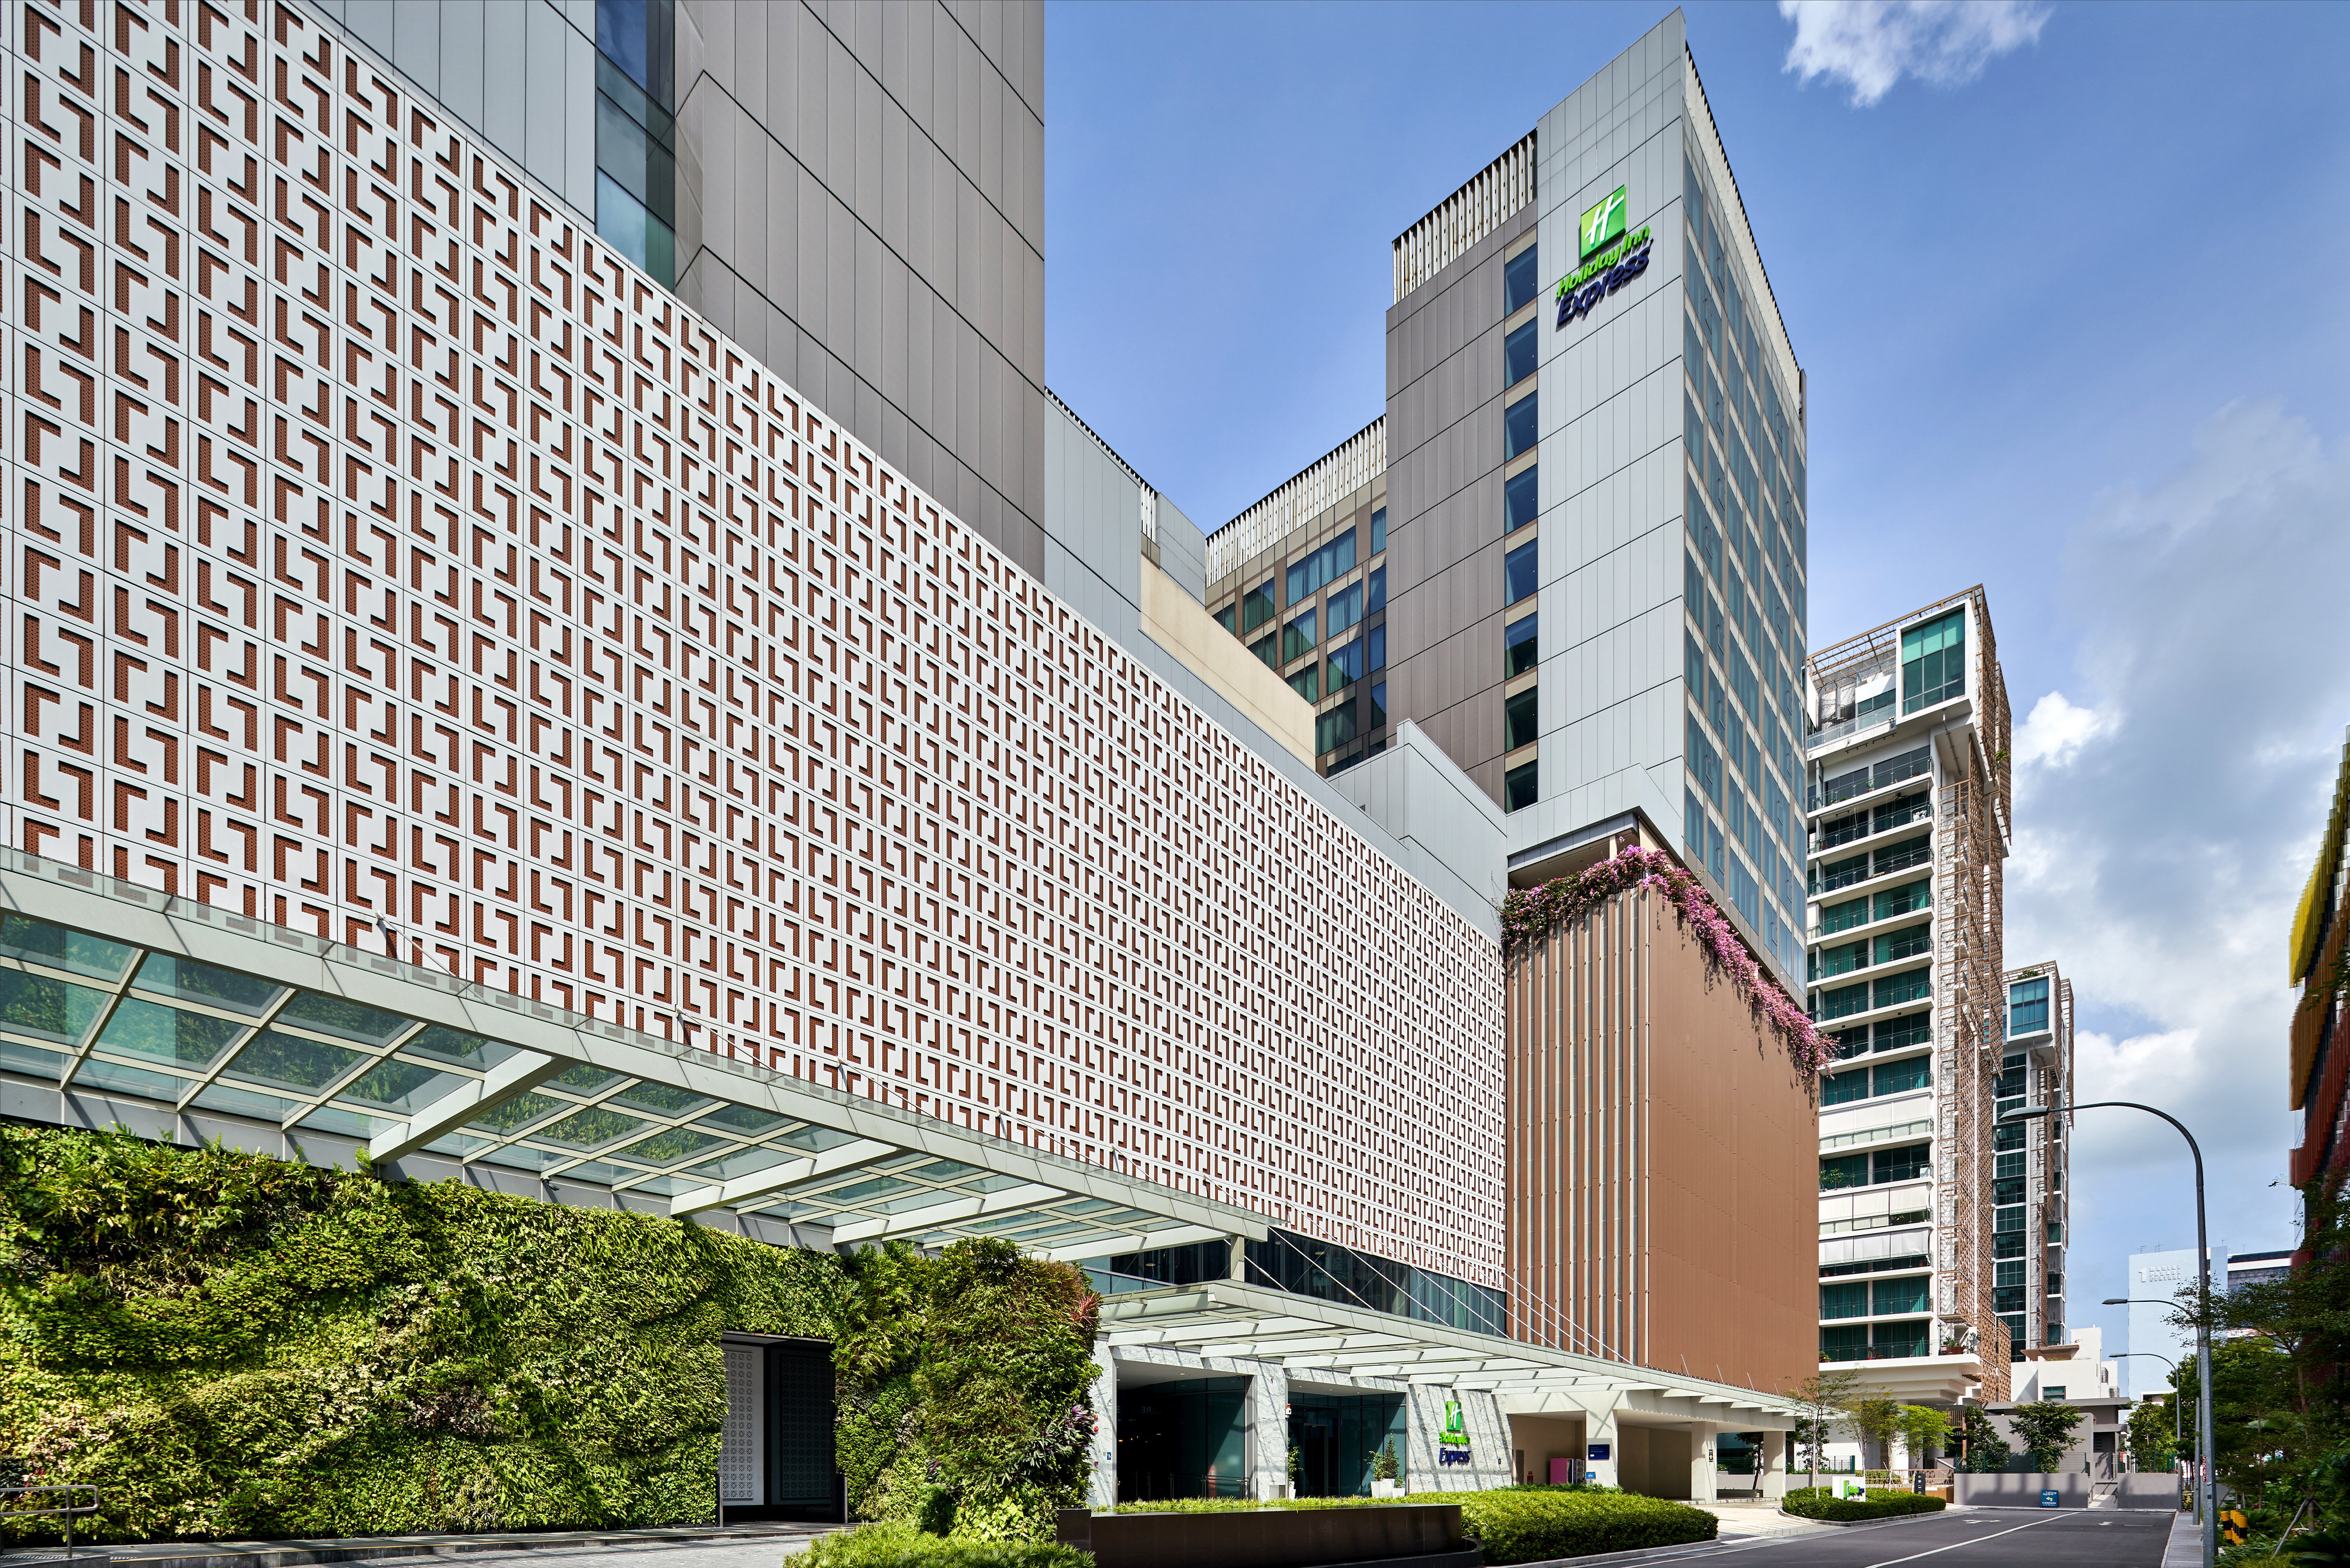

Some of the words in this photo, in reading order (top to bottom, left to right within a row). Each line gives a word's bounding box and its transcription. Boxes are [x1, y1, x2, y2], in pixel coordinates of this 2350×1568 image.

[1557, 244, 1621, 298] Holiday
[1622, 226, 1650, 253] Inn
[1557, 238, 1654, 325] Express
[2138, 1267, 2147, 1282] 1
[1439, 1448, 1471, 1466] Express
